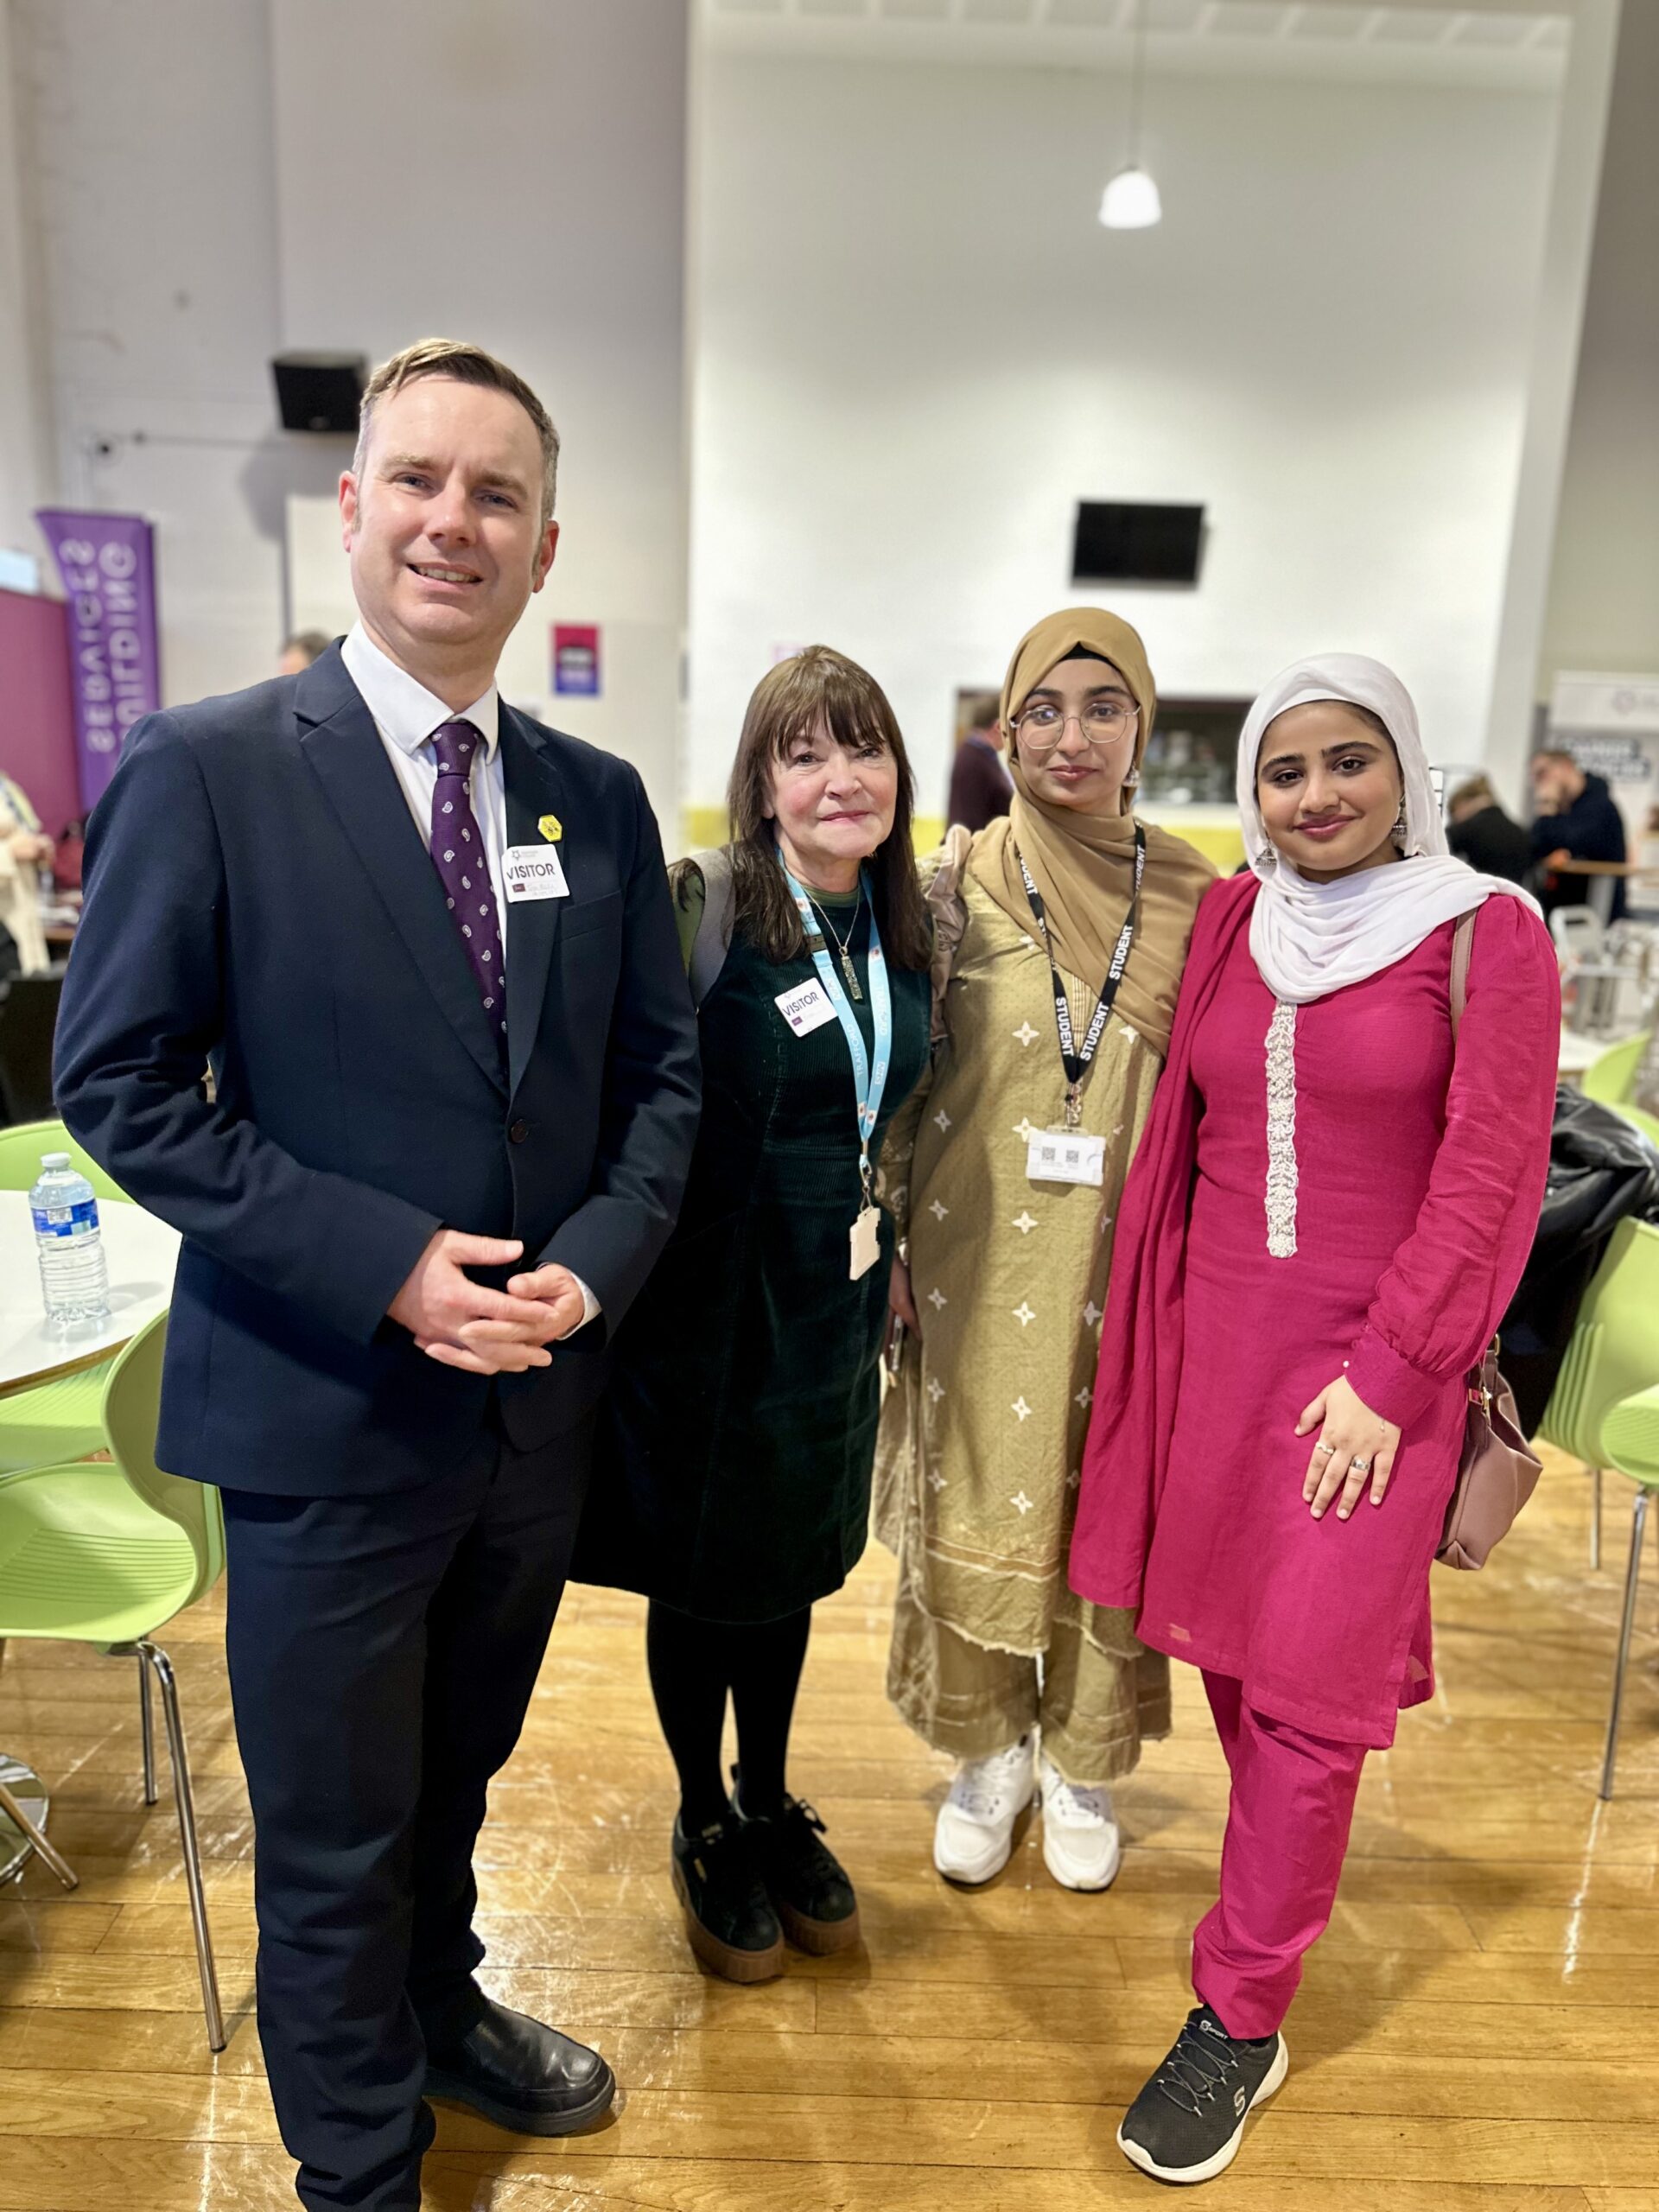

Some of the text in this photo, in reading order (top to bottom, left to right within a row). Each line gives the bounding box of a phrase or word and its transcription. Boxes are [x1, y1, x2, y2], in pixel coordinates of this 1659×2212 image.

[506, 863, 556, 880] VISITOR
[1109, 925, 1134, 981] STUDENT
[782, 991, 819, 1016] VISITOR
[1055, 996, 1074, 1057] STUDENT
[1080, 1001, 1109, 1061] STUDENT
